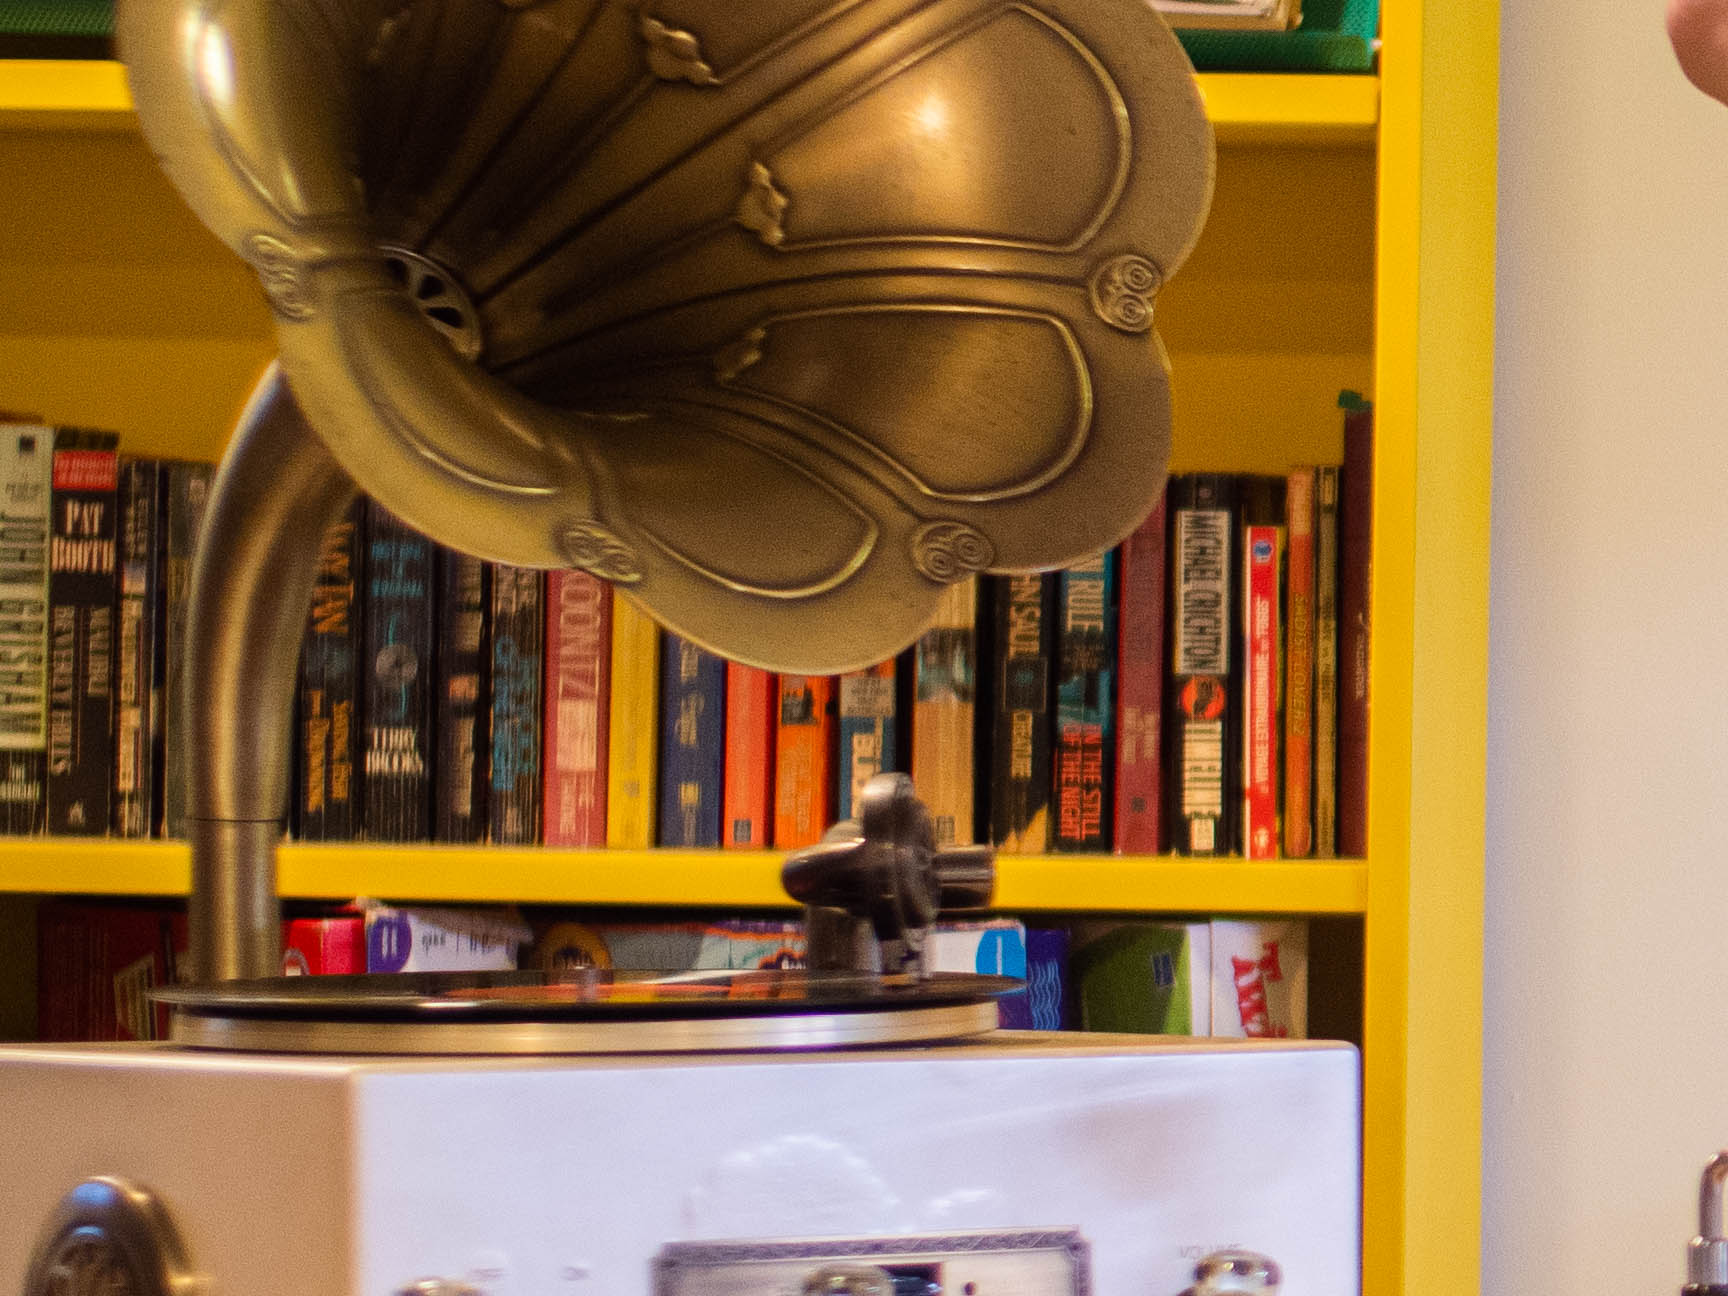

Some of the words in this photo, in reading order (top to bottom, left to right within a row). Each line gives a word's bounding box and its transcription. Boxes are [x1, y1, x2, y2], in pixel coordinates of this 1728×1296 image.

[64, 498, 105, 536] PAT
[1182, 515, 1223, 587] MICHAEL
[310, 579, 354, 635] TAN
[1007, 606, 1042, 662] SAUL
[1065, 579, 1105, 633] RULE
[1182, 590, 1223, 670] CRICHTON
[51, 605, 75, 703] BEVERLY
[49, 709, 73, 776] HILLS
[1060, 748, 1080, 784] THE
[1081, 749, 1101, 785] THE
[1182, 721, 1221, 818] TIMELINE
[1057, 785, 1080, 840] NIGHT
[1080, 789, 1101, 839] STILL
